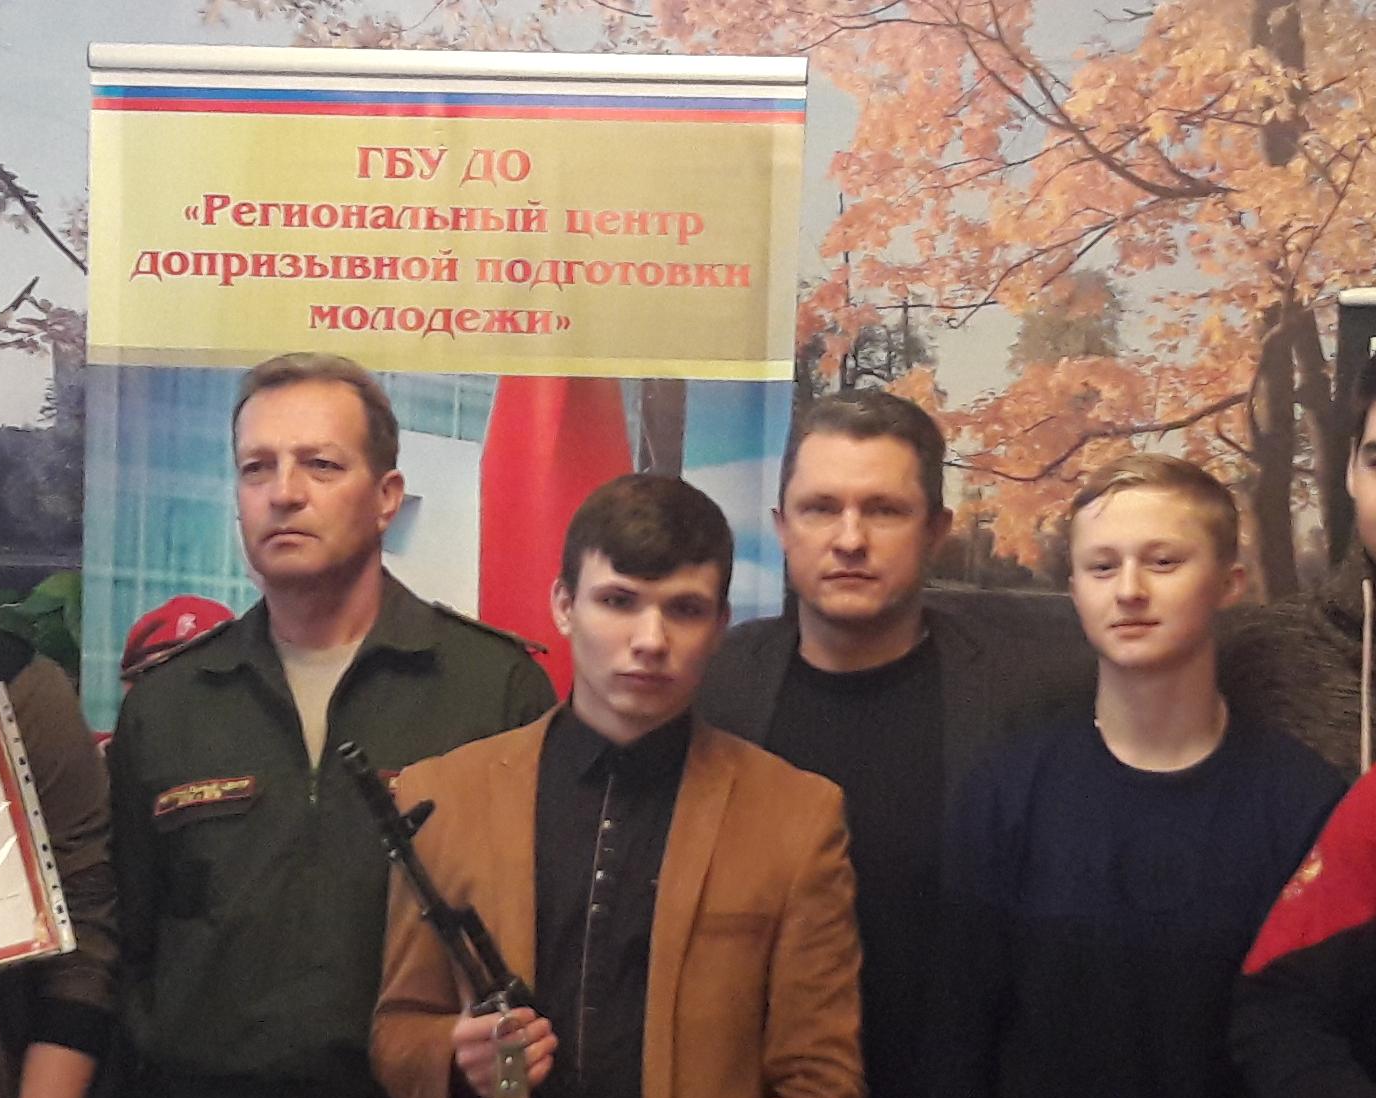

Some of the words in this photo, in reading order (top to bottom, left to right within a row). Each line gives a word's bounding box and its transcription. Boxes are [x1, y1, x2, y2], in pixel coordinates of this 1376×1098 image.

[356, 144, 449, 180] ГБУ
[460, 148, 532, 188] ДО
[184, 193, 548, 233] «Региональный
[564, 208, 705, 246] центр
[129, 248, 459, 286] допризывной
[475, 258, 752, 292] подготовки
[309, 303, 572, 340] молодежи»
